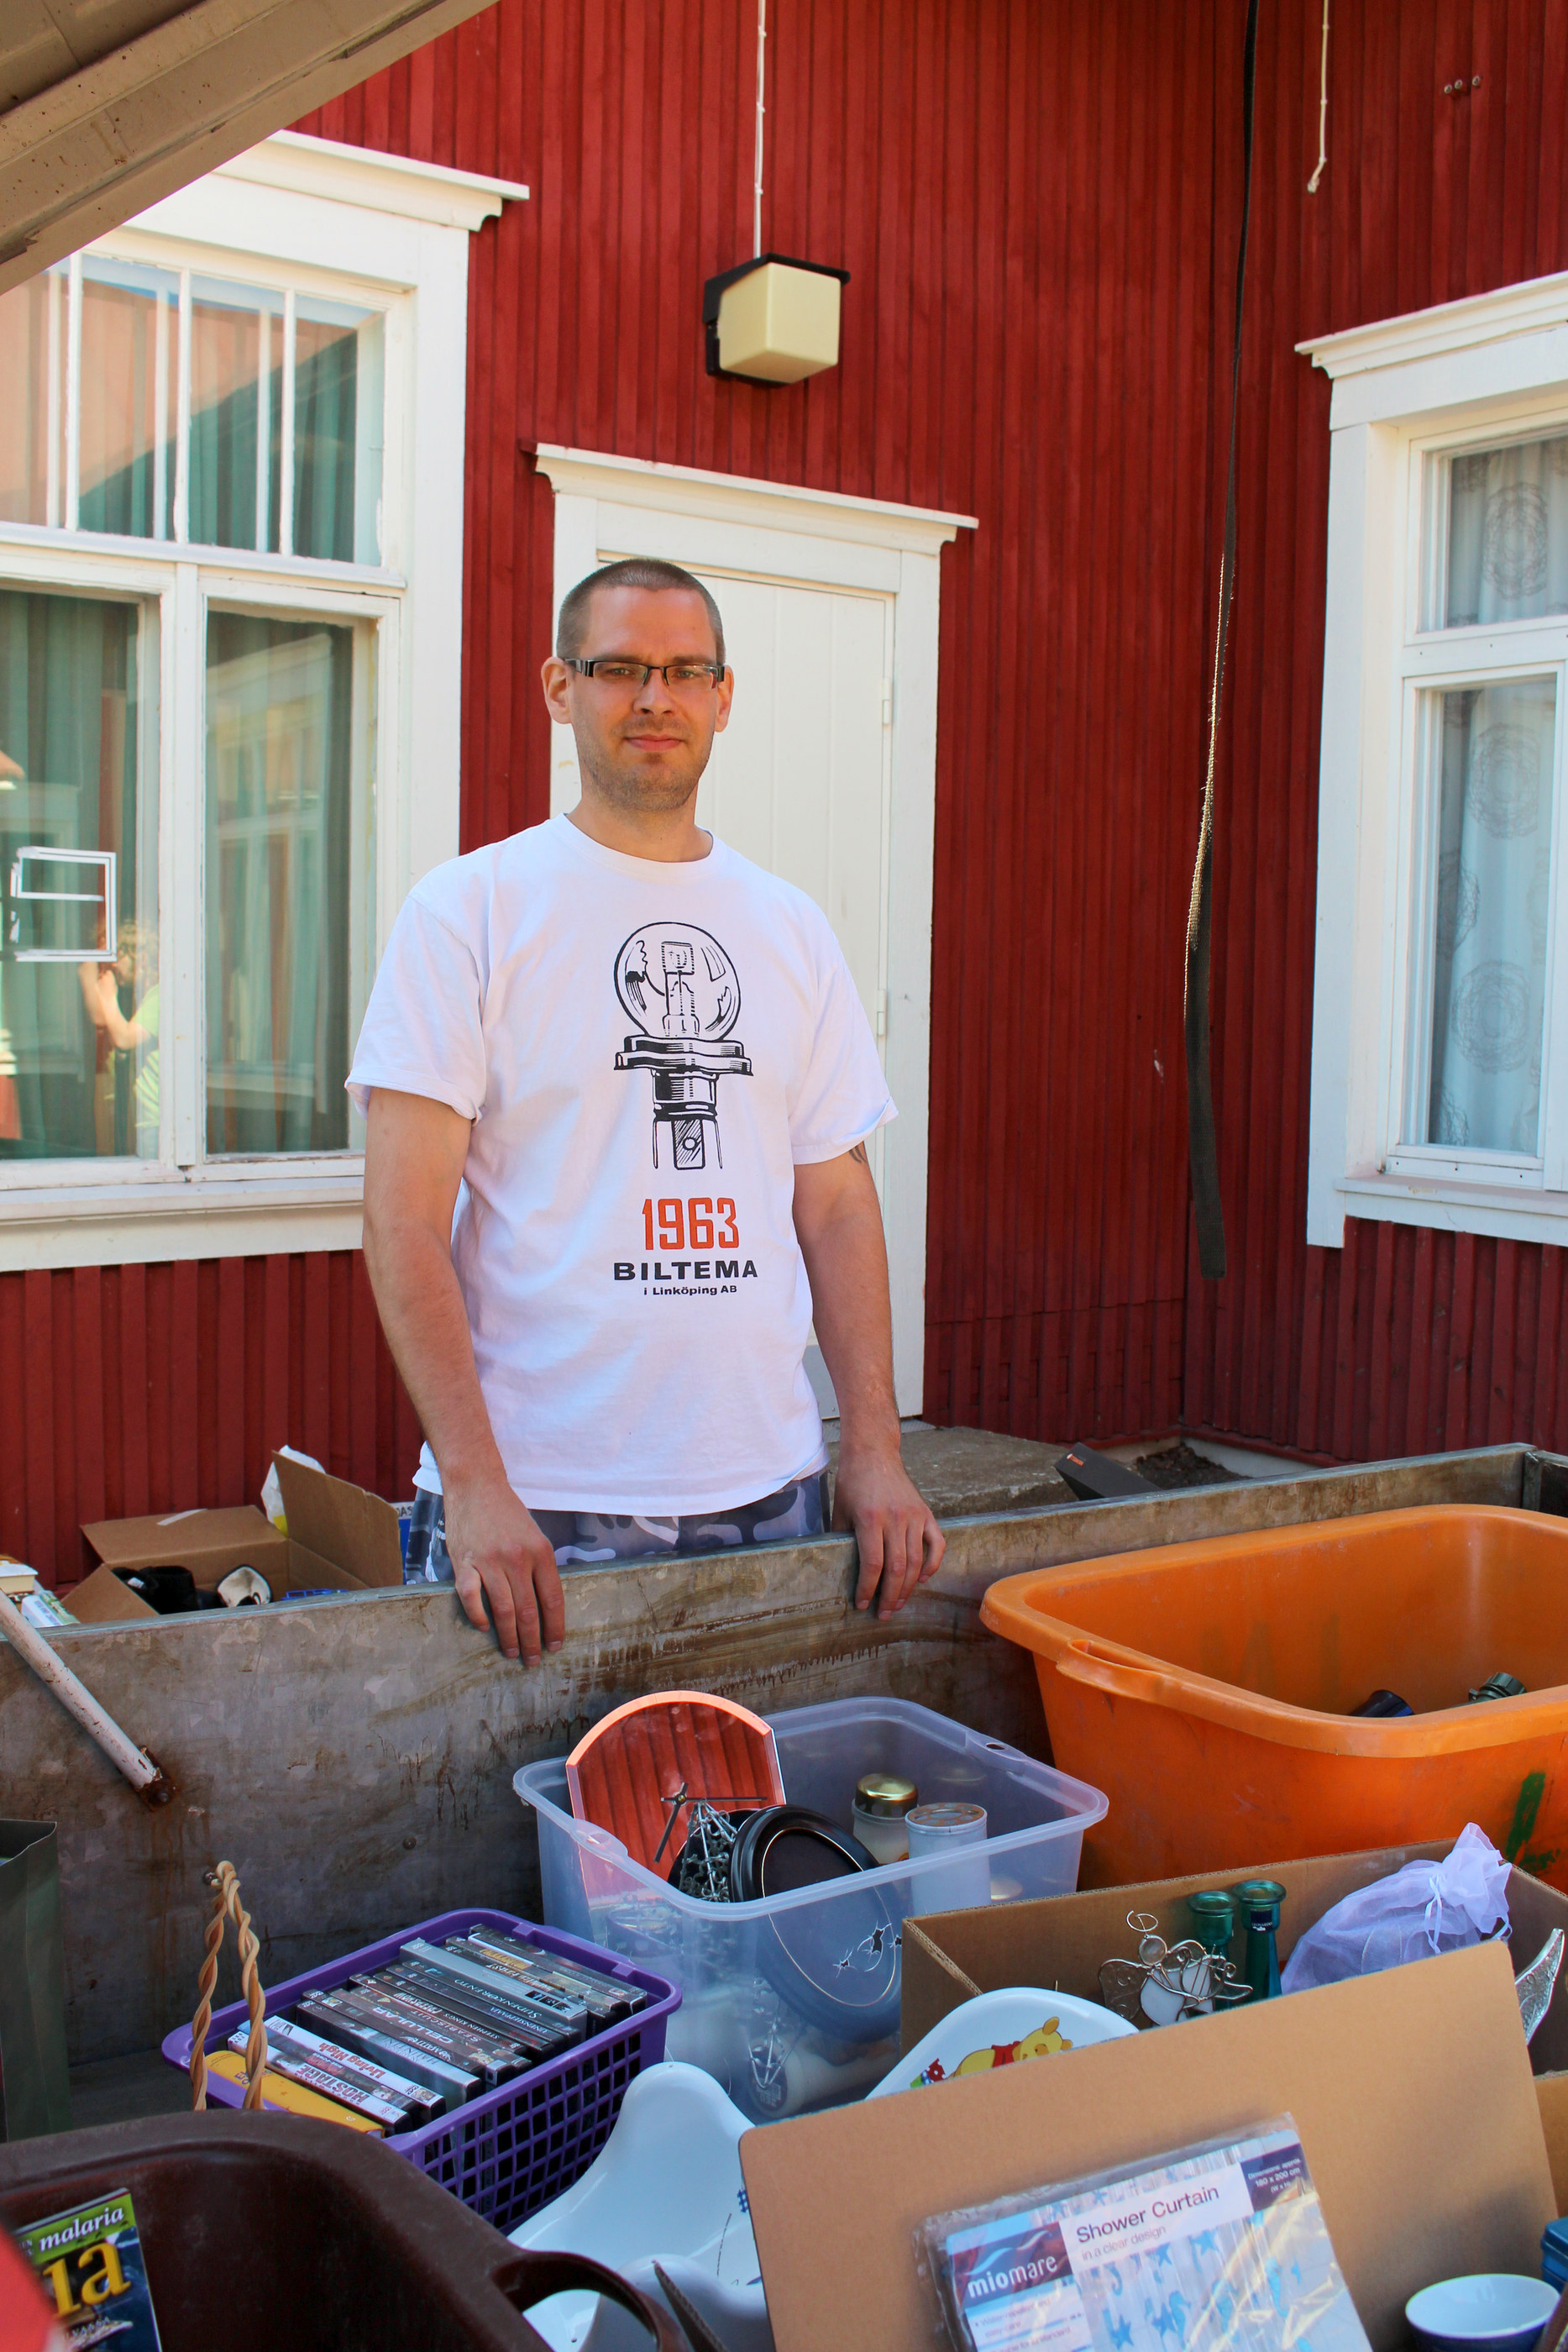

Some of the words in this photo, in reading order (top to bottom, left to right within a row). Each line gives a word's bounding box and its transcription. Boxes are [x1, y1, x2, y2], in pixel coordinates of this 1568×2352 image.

[642, 1197, 740, 1251] 1963
[613, 1259, 758, 1281] BILTEMA
[643, 1287, 648, 1295] i
[652, 1285, 718, 1296] Linköping
[720, 1284, 737, 1294] AB
[371, 2006, 454, 2045] CELLULAR
[410, 2009, 481, 2043] SEABISCUIT
[299, 2063, 370, 2104] HOSTAGE
[349, 2053, 386, 2080] Living
[1275, 2171, 1289, 2181] 200
[1289, 2166, 1302, 2176] cm
[39, 2207, 124, 2252] malaria
[1076, 2208, 1146, 2244] Shower
[1151, 2186, 1220, 2218] Curtain
[1081, 2248, 1093, 2262] in
[1093, 2247, 1102, 2258] a
[1103, 2235, 1129, 2255] clear
[1130, 2224, 1167, 2247] design
[967, 2255, 1058, 2298] miomare
